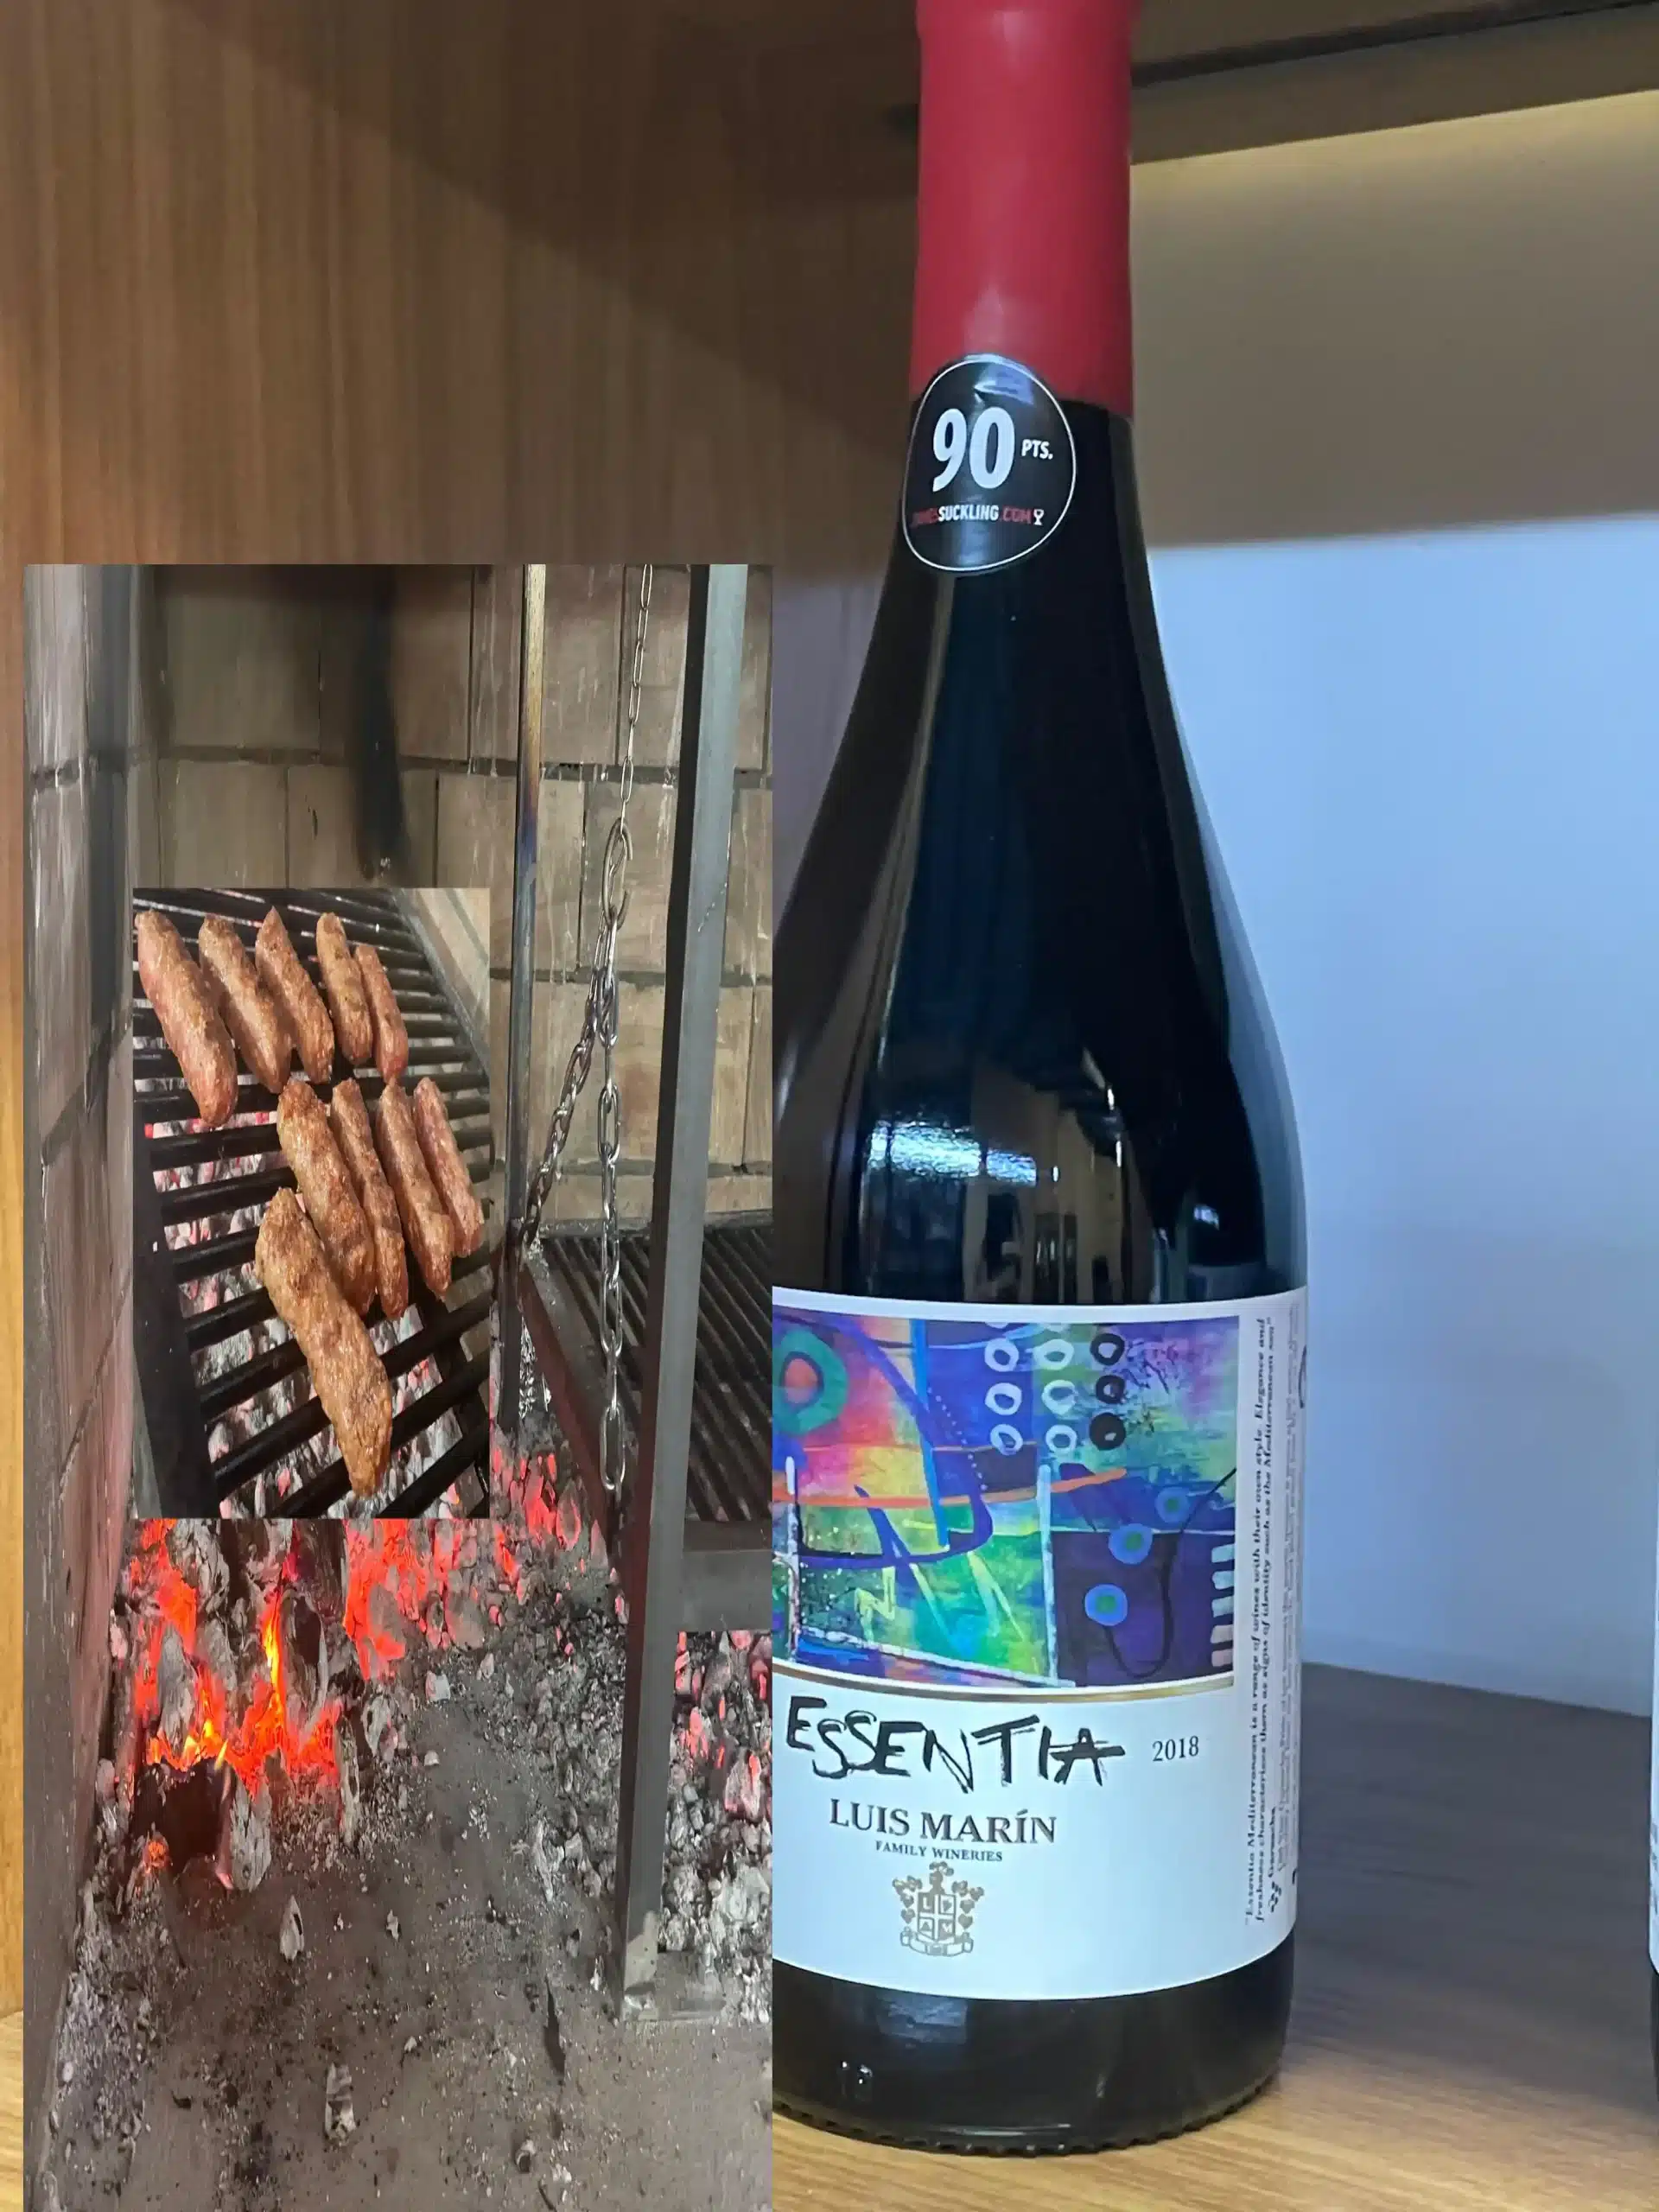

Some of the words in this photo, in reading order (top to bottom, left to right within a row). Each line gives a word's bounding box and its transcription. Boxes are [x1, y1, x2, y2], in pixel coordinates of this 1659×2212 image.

[932, 406, 1015, 492] 90
[1020, 439, 1053, 460] PTS.
[786, 1695, 1126, 1794] ESSENTIA
[1152, 1735, 1200, 1762] 2018
[830, 1797, 911, 1837] LUIS
[919, 1808, 1057, 1844] MARÍN
[875, 1840, 928, 1858] FAMILY
[931, 1847, 1002, 1862] WINERIES
